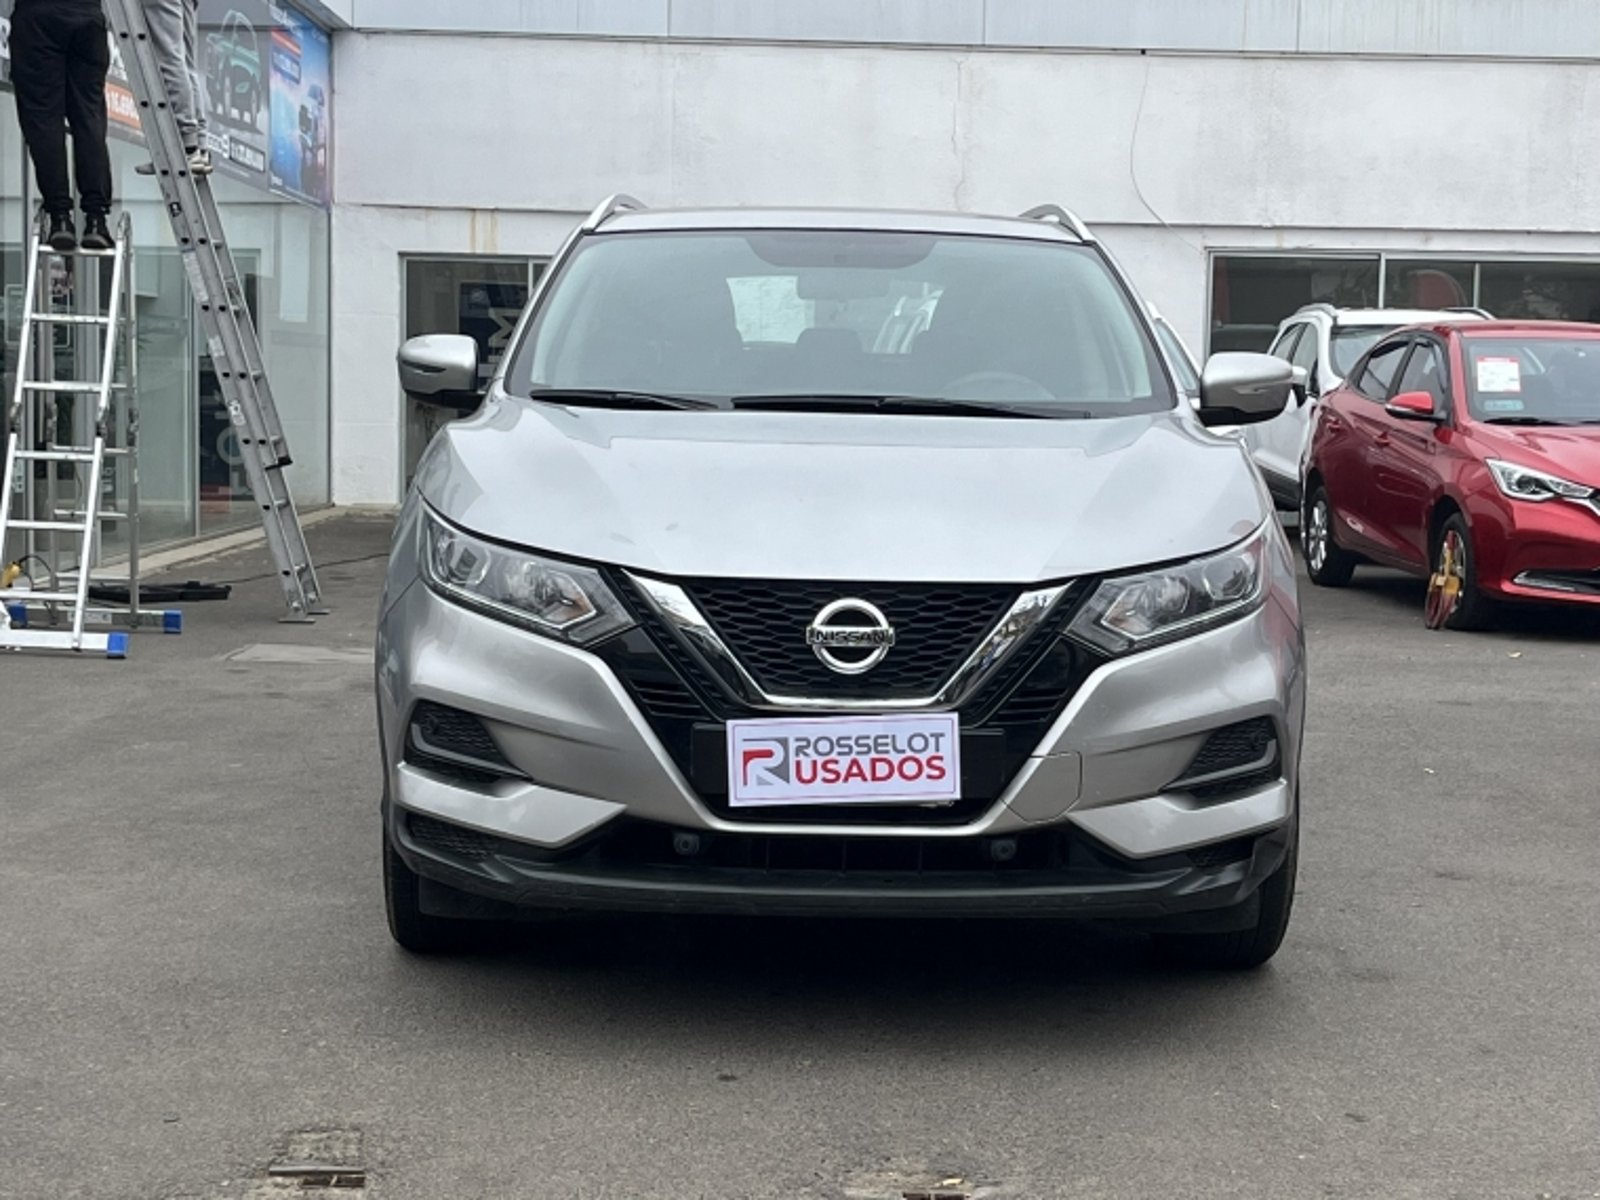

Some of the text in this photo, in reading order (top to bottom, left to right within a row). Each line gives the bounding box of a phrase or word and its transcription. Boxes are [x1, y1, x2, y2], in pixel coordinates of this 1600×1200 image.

[814, 629, 887, 645] NISSAN
[794, 732, 945, 758] ROSSELOT
[795, 754, 946, 785] USADOS
